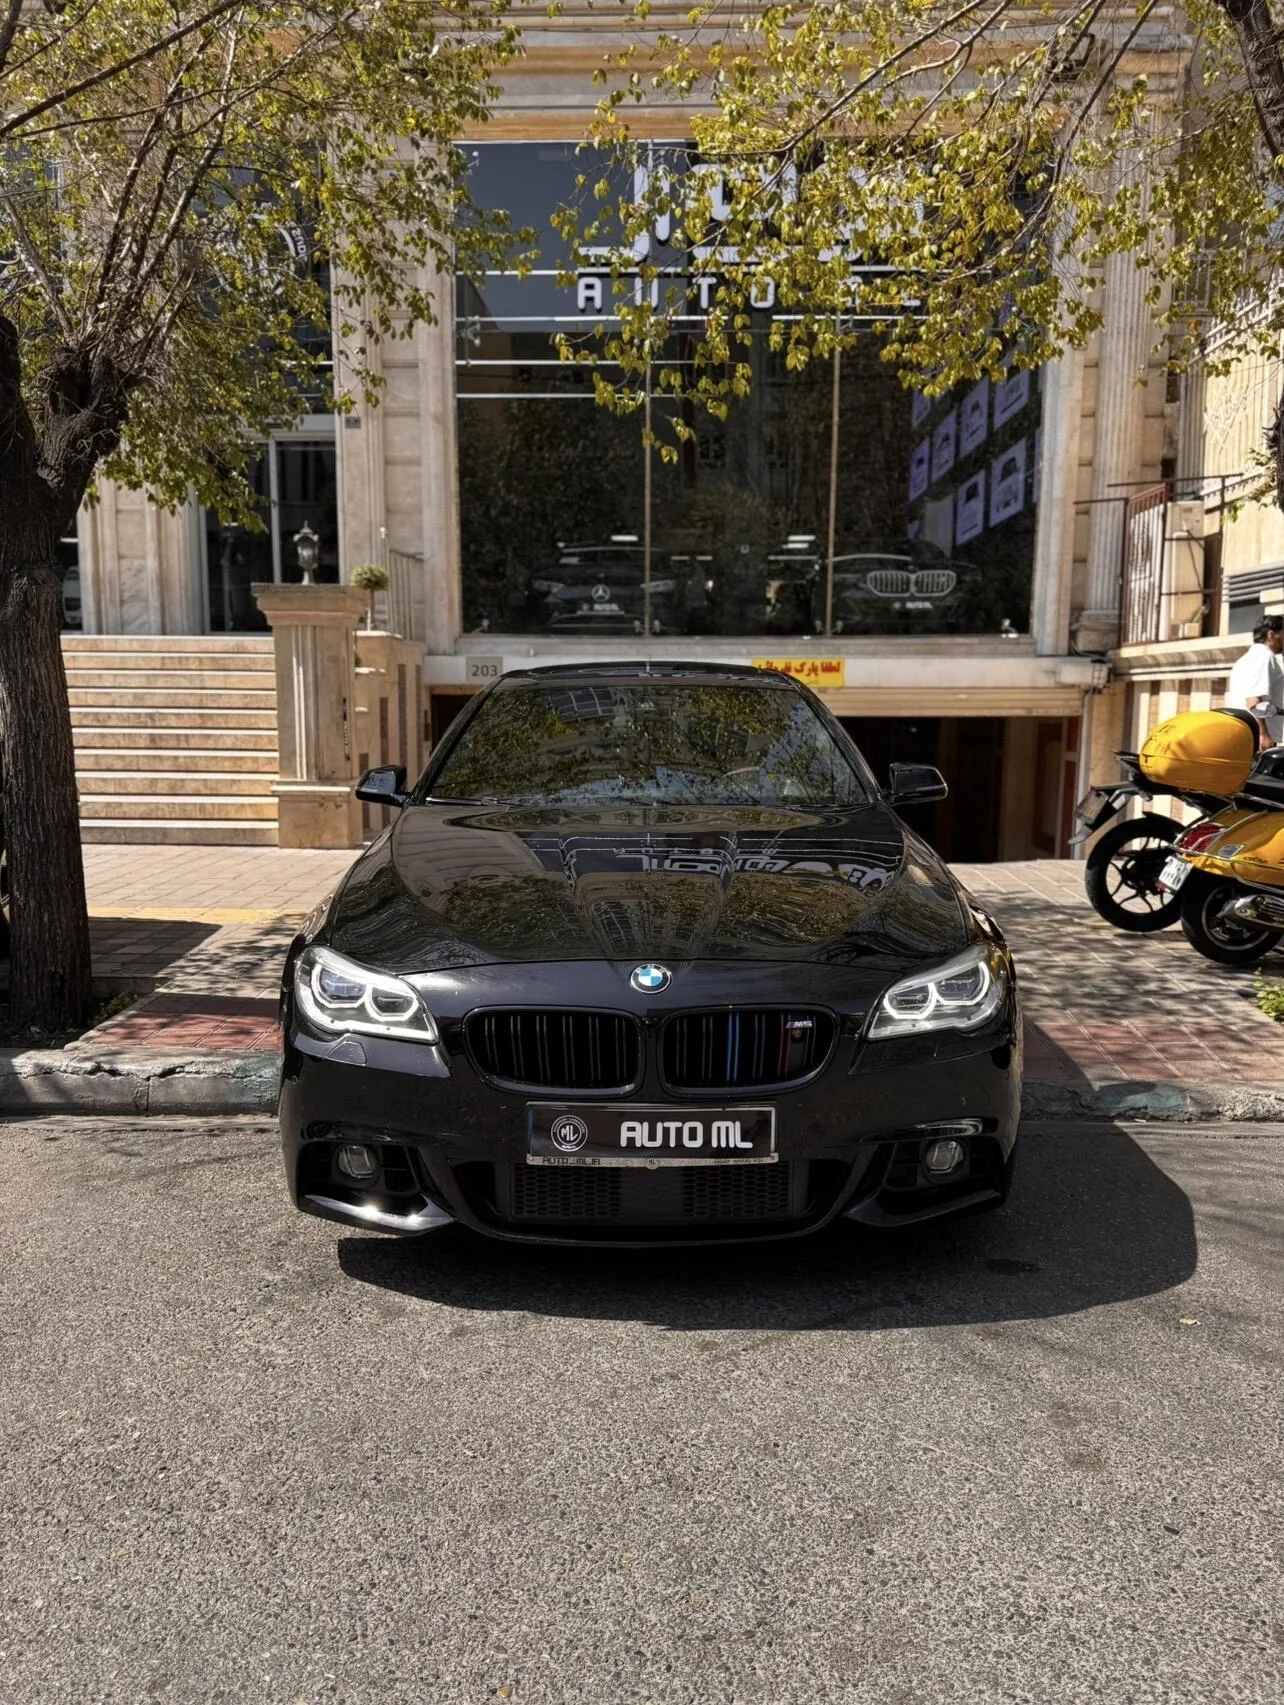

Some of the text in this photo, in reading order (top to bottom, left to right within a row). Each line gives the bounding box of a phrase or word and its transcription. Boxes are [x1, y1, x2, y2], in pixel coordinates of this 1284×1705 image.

[471, 664, 498, 677] 203
[560, 1125, 578, 1141] ML
[620, 1121, 753, 1148] AUTO ML
